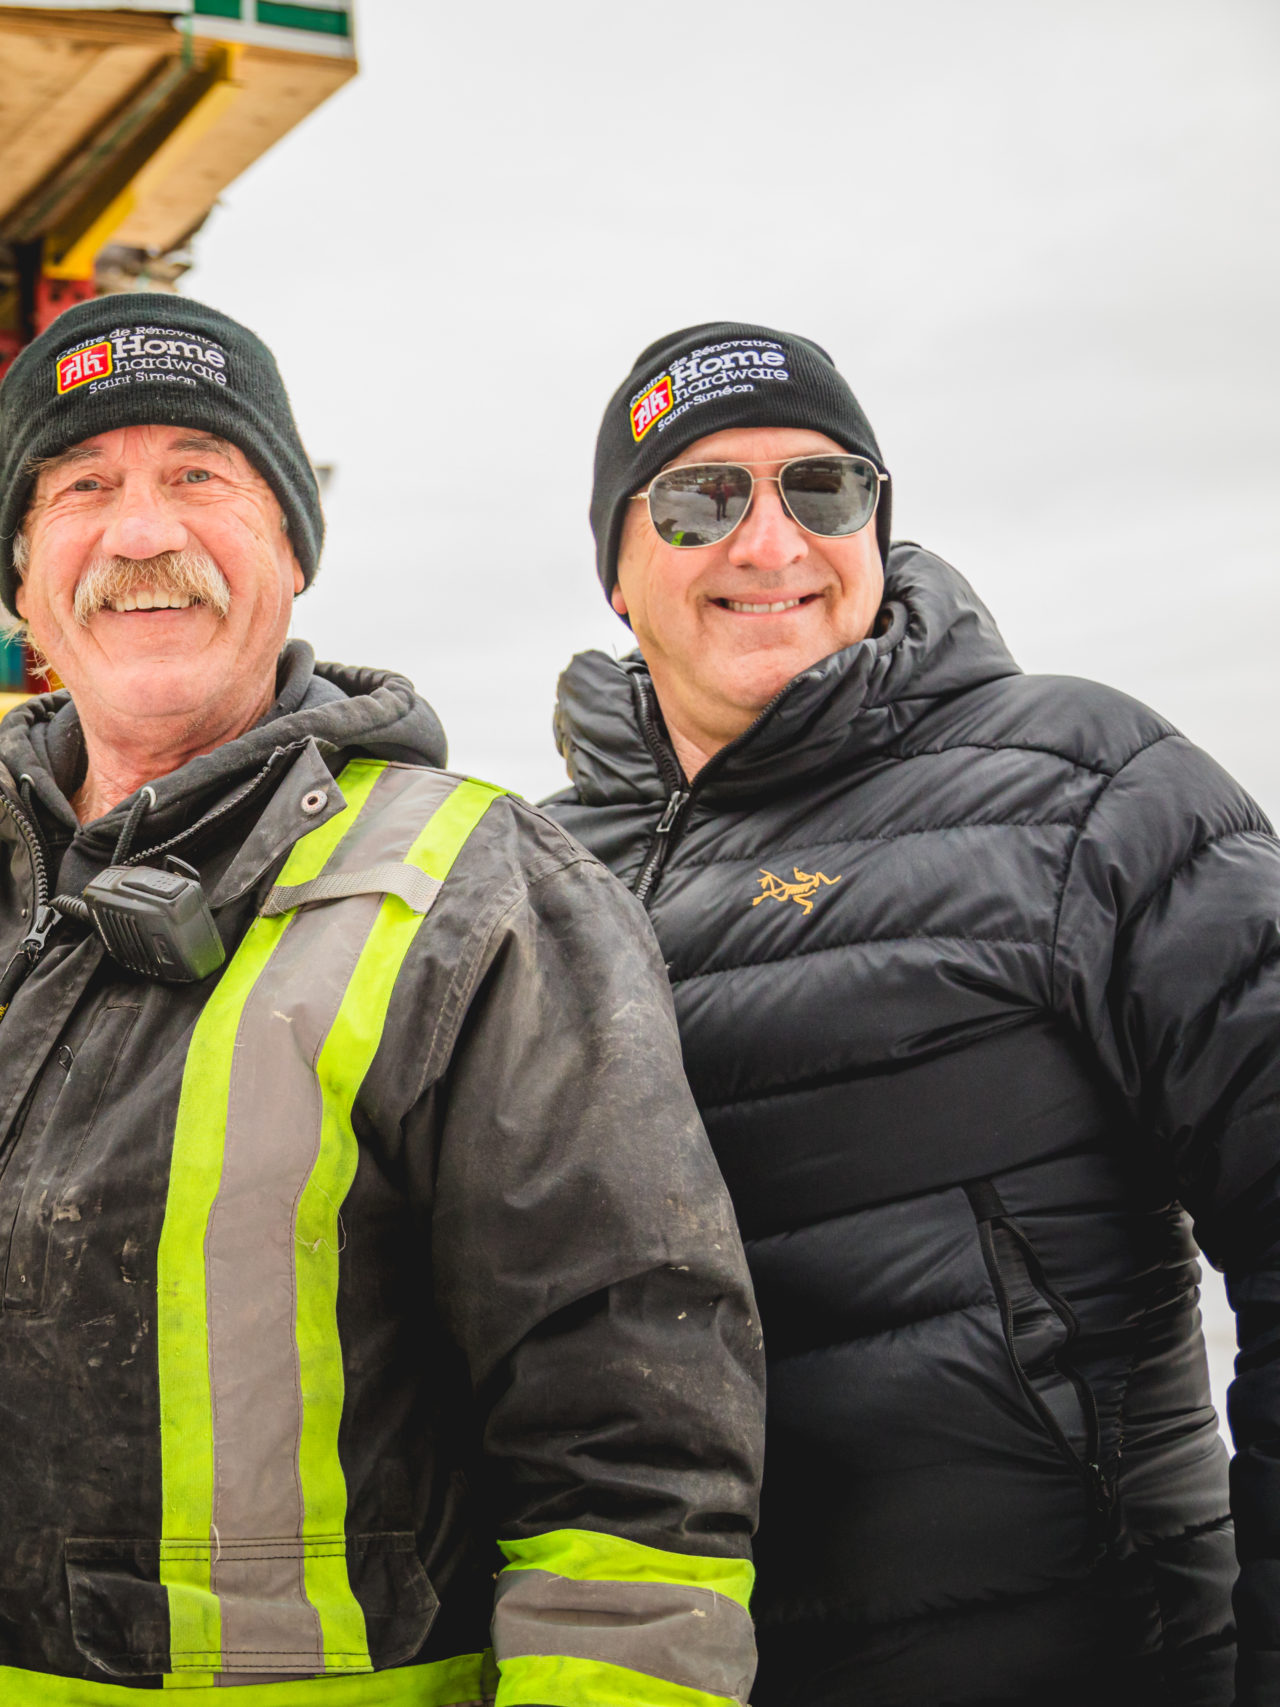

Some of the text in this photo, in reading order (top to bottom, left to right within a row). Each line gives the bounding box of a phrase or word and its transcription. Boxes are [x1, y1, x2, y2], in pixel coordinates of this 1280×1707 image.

[109, 328, 131, 339] de
[111, 335, 226, 368] Home
[668, 356, 688, 371] de
[691, 339, 783, 360] Rénovation
[88, 371, 197, 395] Saint Siméon
[114, 355, 227, 386] hardware
[670, 350, 786, 391] Home
[673, 367, 789, 404] hardware
